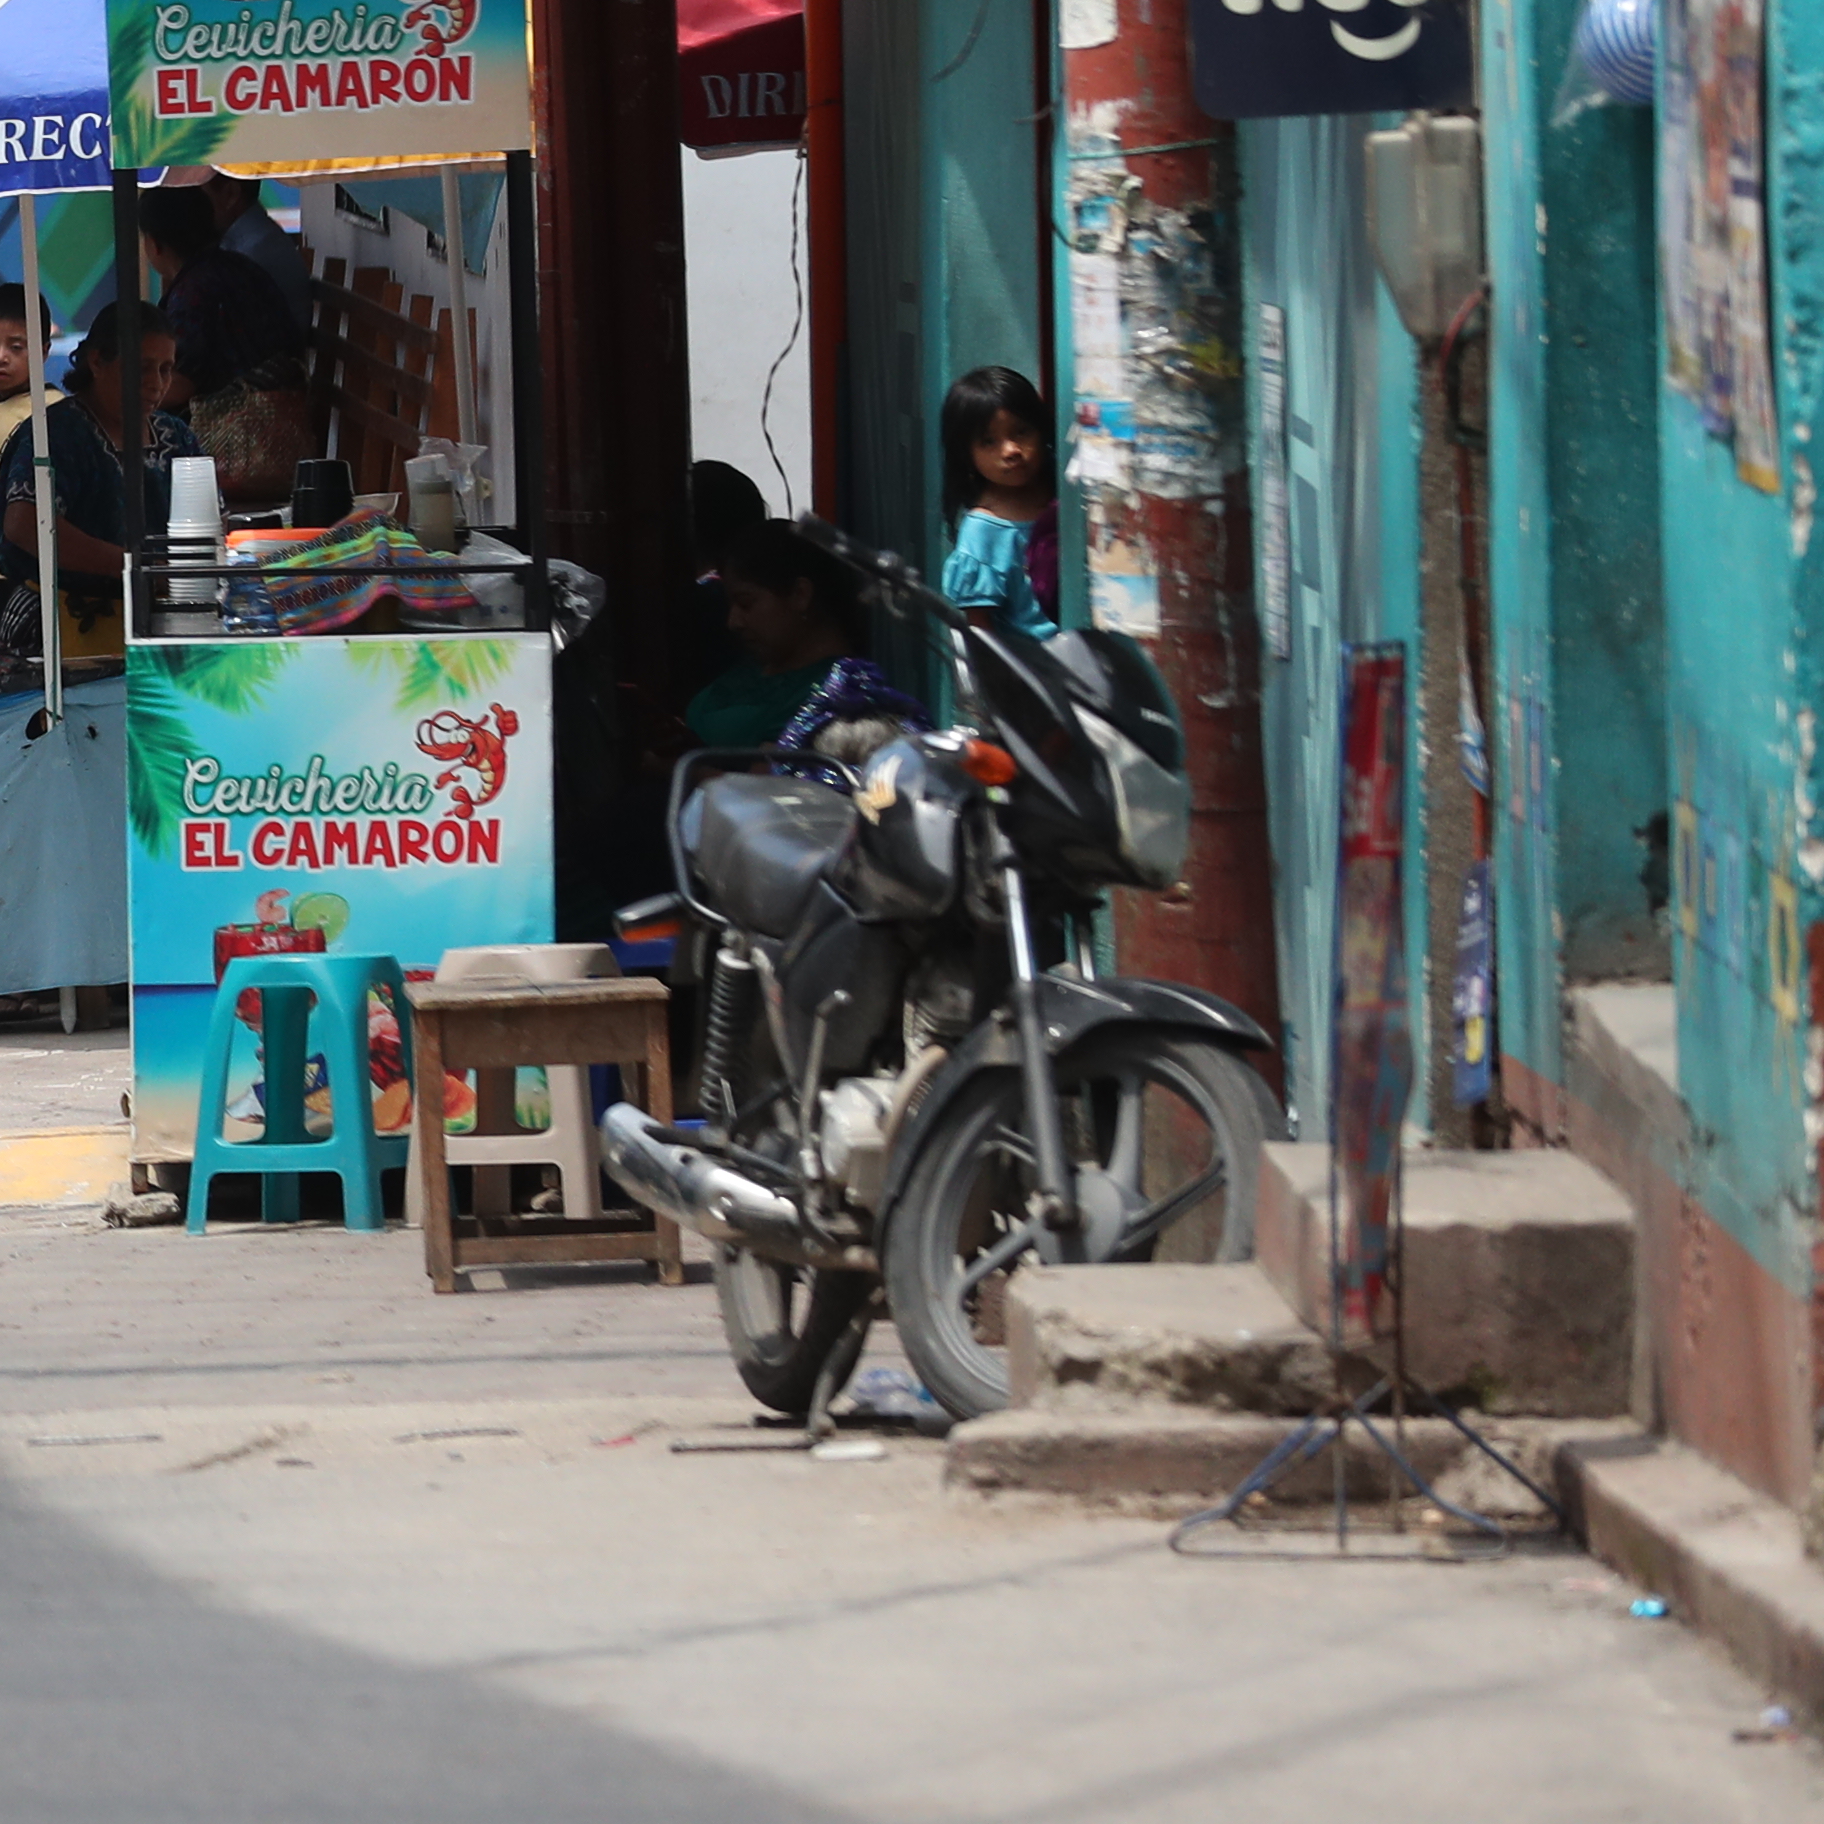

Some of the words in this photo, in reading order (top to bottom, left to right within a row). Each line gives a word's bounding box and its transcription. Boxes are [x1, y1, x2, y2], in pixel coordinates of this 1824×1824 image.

[155, 0, 402, 62] Cevicheria
[156, 66, 214, 116] EL
[185, 755, 433, 815] Cevicheria
[184, 821, 239, 868] EL
